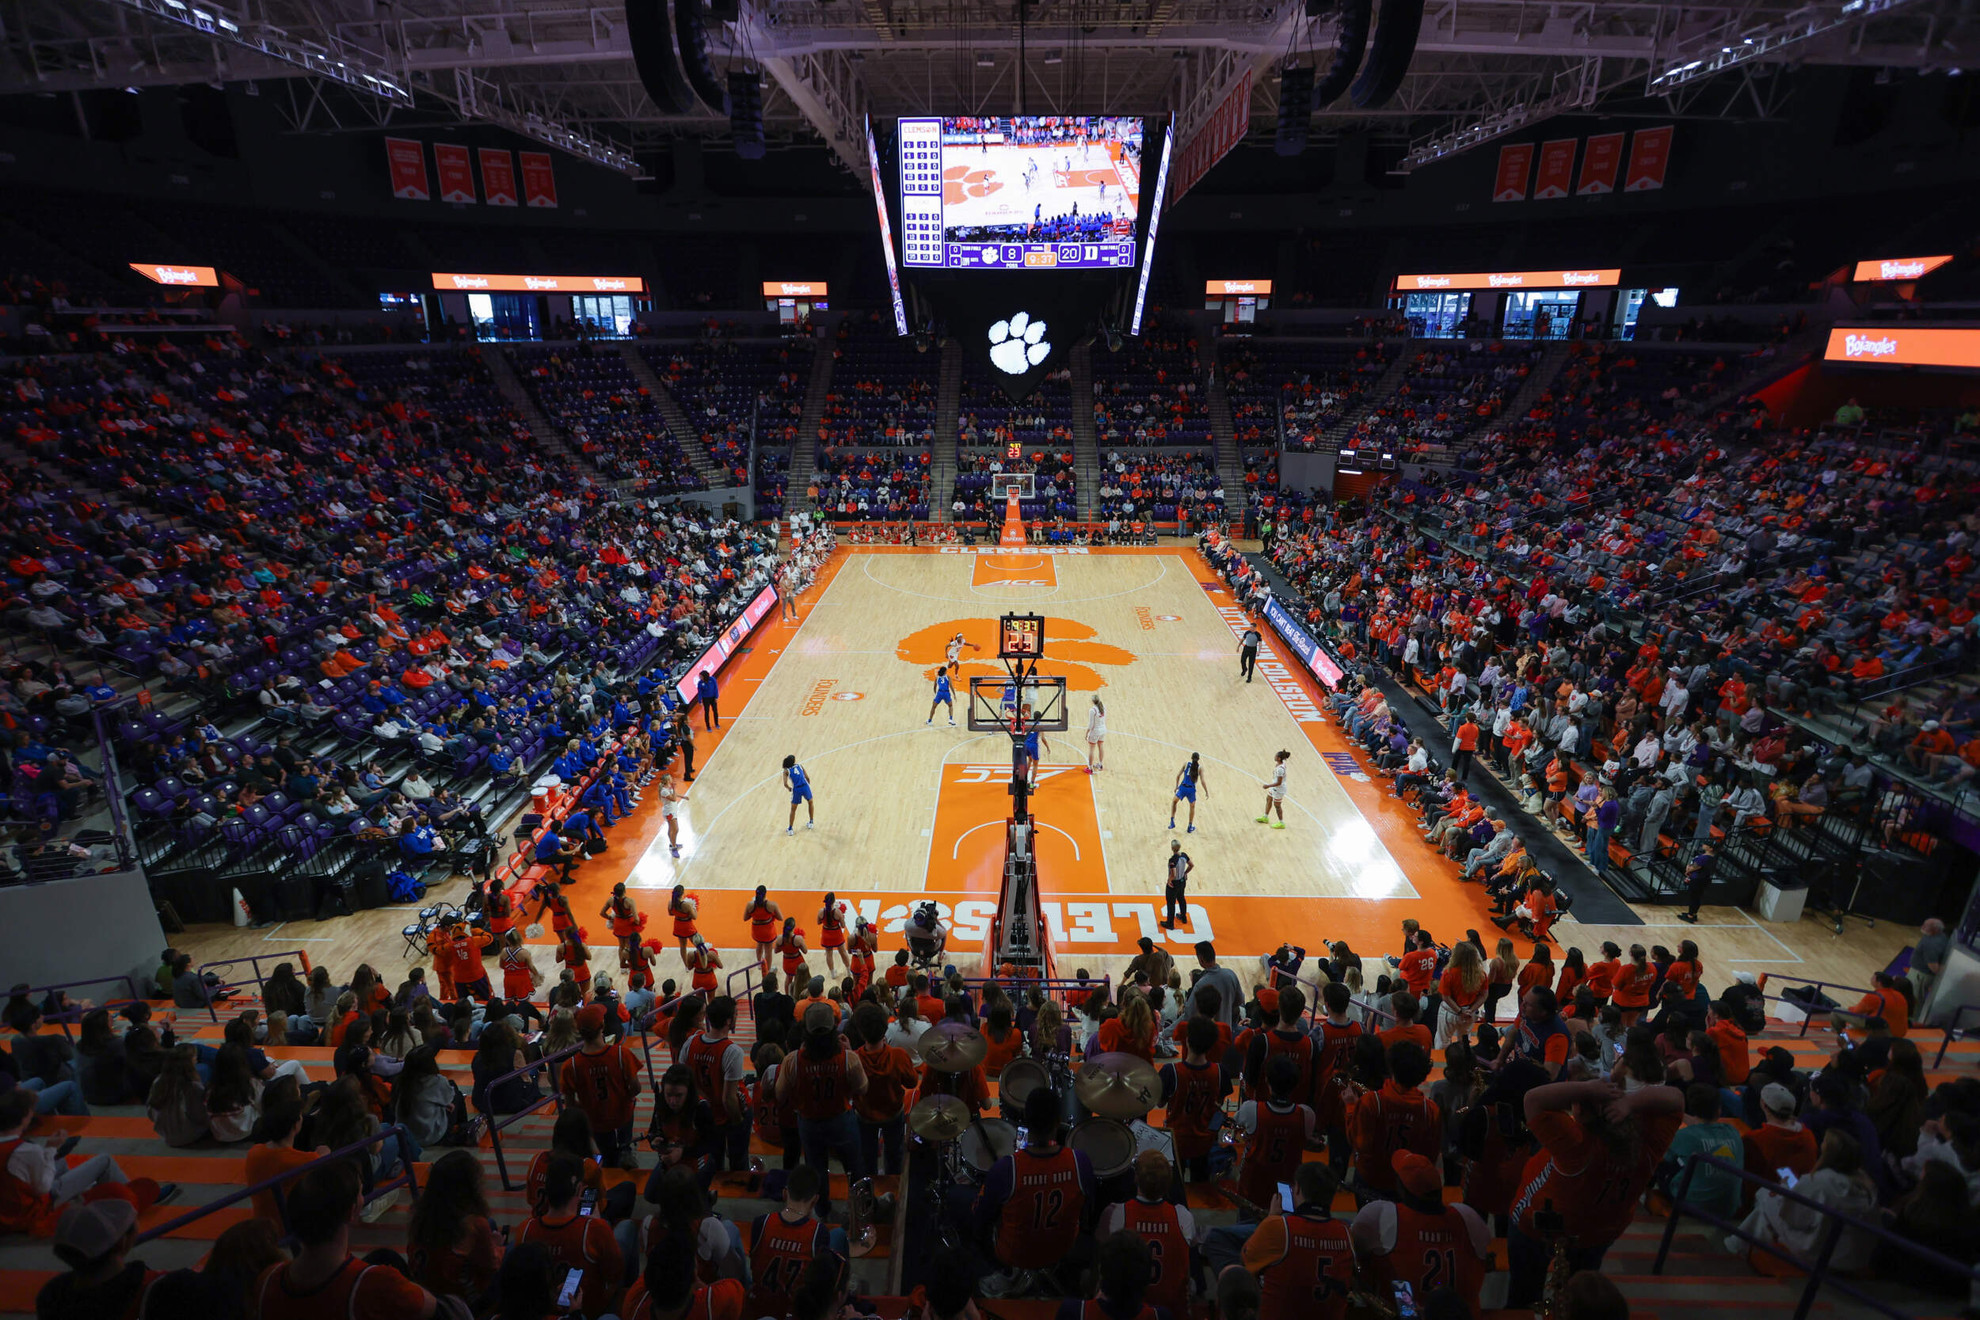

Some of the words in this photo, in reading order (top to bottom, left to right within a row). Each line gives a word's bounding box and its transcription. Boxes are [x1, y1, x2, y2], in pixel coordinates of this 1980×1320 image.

[1008, 248, 1016, 259] 8
[1029, 254, 1052, 264] 9:37
[1062, 248, 1078, 259] 20
[1562, 272, 1600, 285] Bojangles
[1845, 334, 1896, 356] Bojangles
[1008, 448, 1020, 458] 23
[1012, 620, 1037, 631] 9:37
[1008, 632, 1033, 651] 23
[802, 679, 839, 716] FOUNDERS
[1257, 662, 1326, 722] COLISEUM
[1418, 957, 1434, 970] '26
[1270, 1138, 1288, 1162] 5
[1033, 1188, 1064, 1230] 12
[1313, 1256, 1334, 1302] 5
[1422, 1248, 1456, 1292] 21
